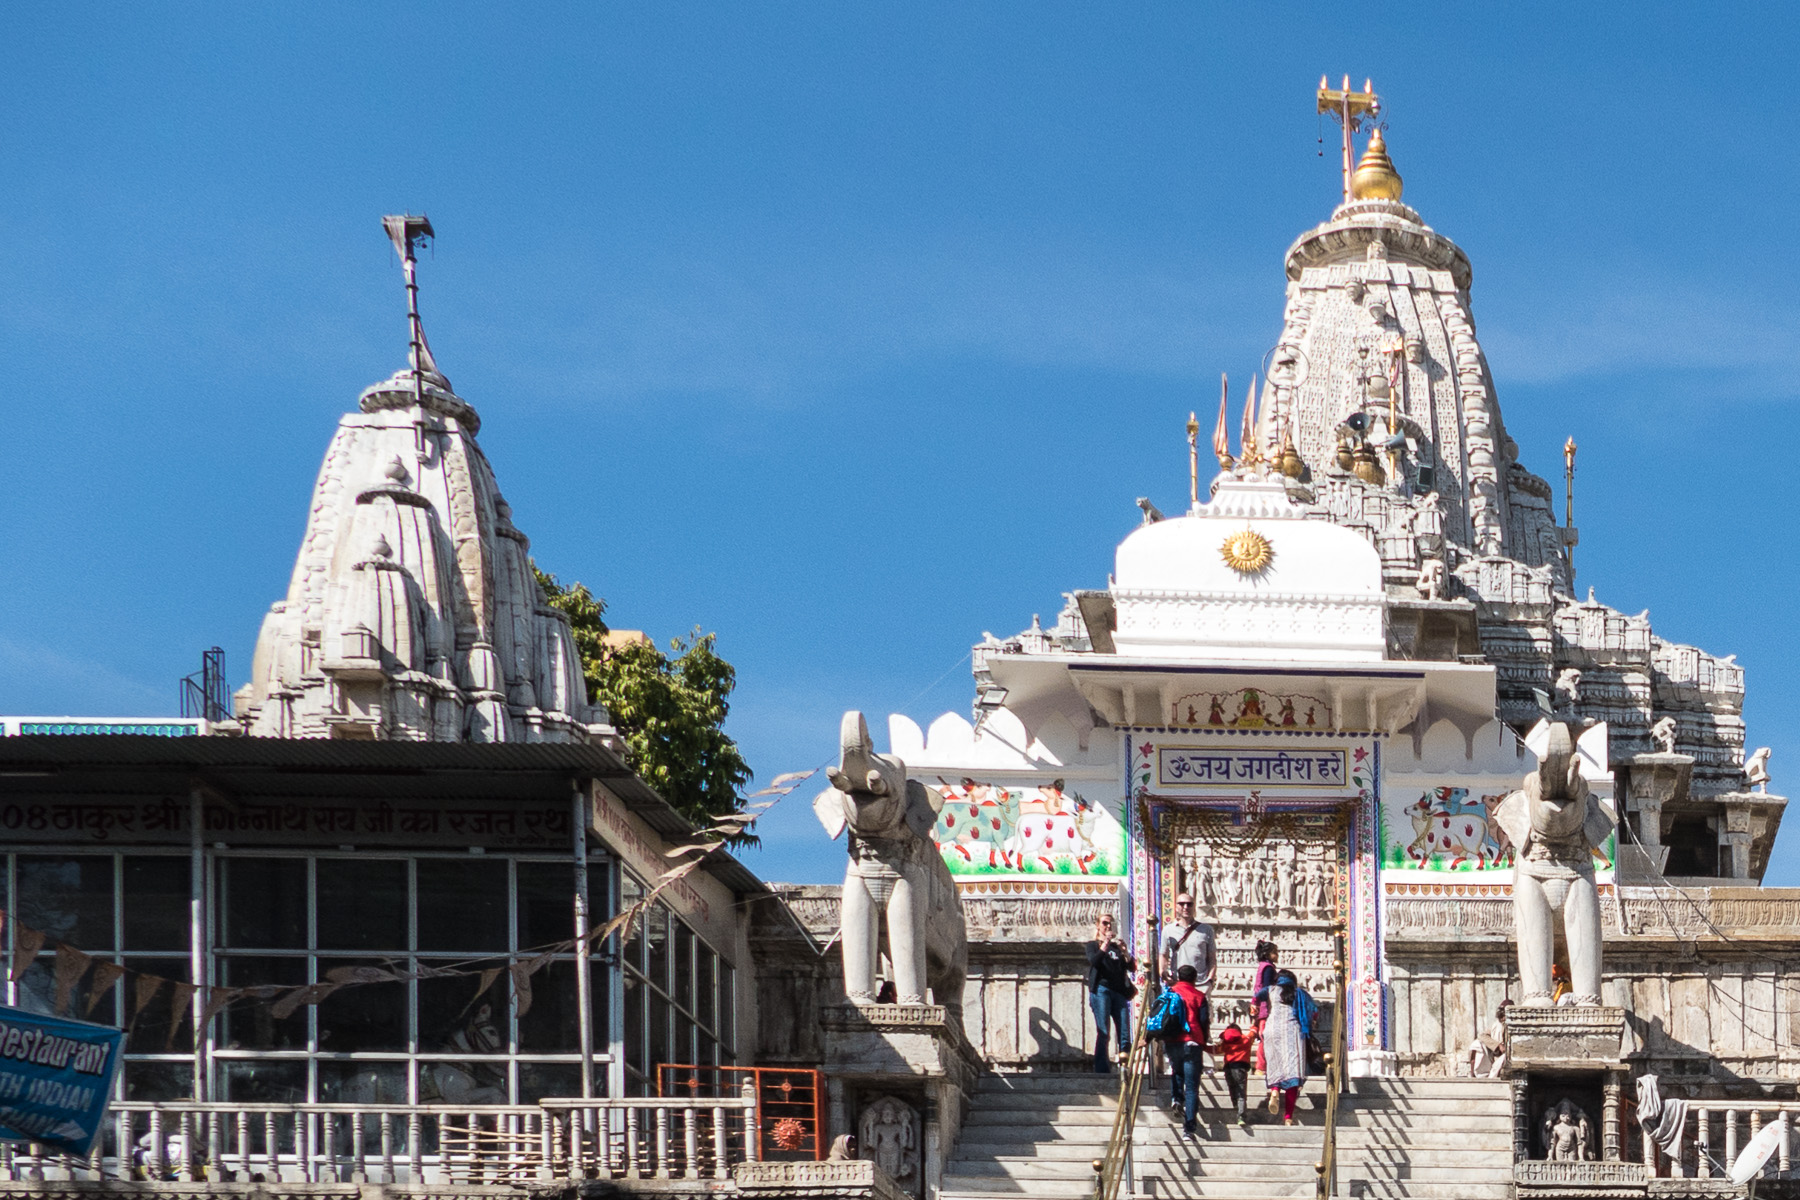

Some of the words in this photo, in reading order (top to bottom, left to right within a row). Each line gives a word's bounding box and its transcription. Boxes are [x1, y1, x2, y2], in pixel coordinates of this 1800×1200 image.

[1190, 757, 1234, 779] जय
[1235, 752, 1314, 780] जगदीश
[1316, 753, 1341, 780] हरे
[186, 803, 307, 832] गन्नाथ
